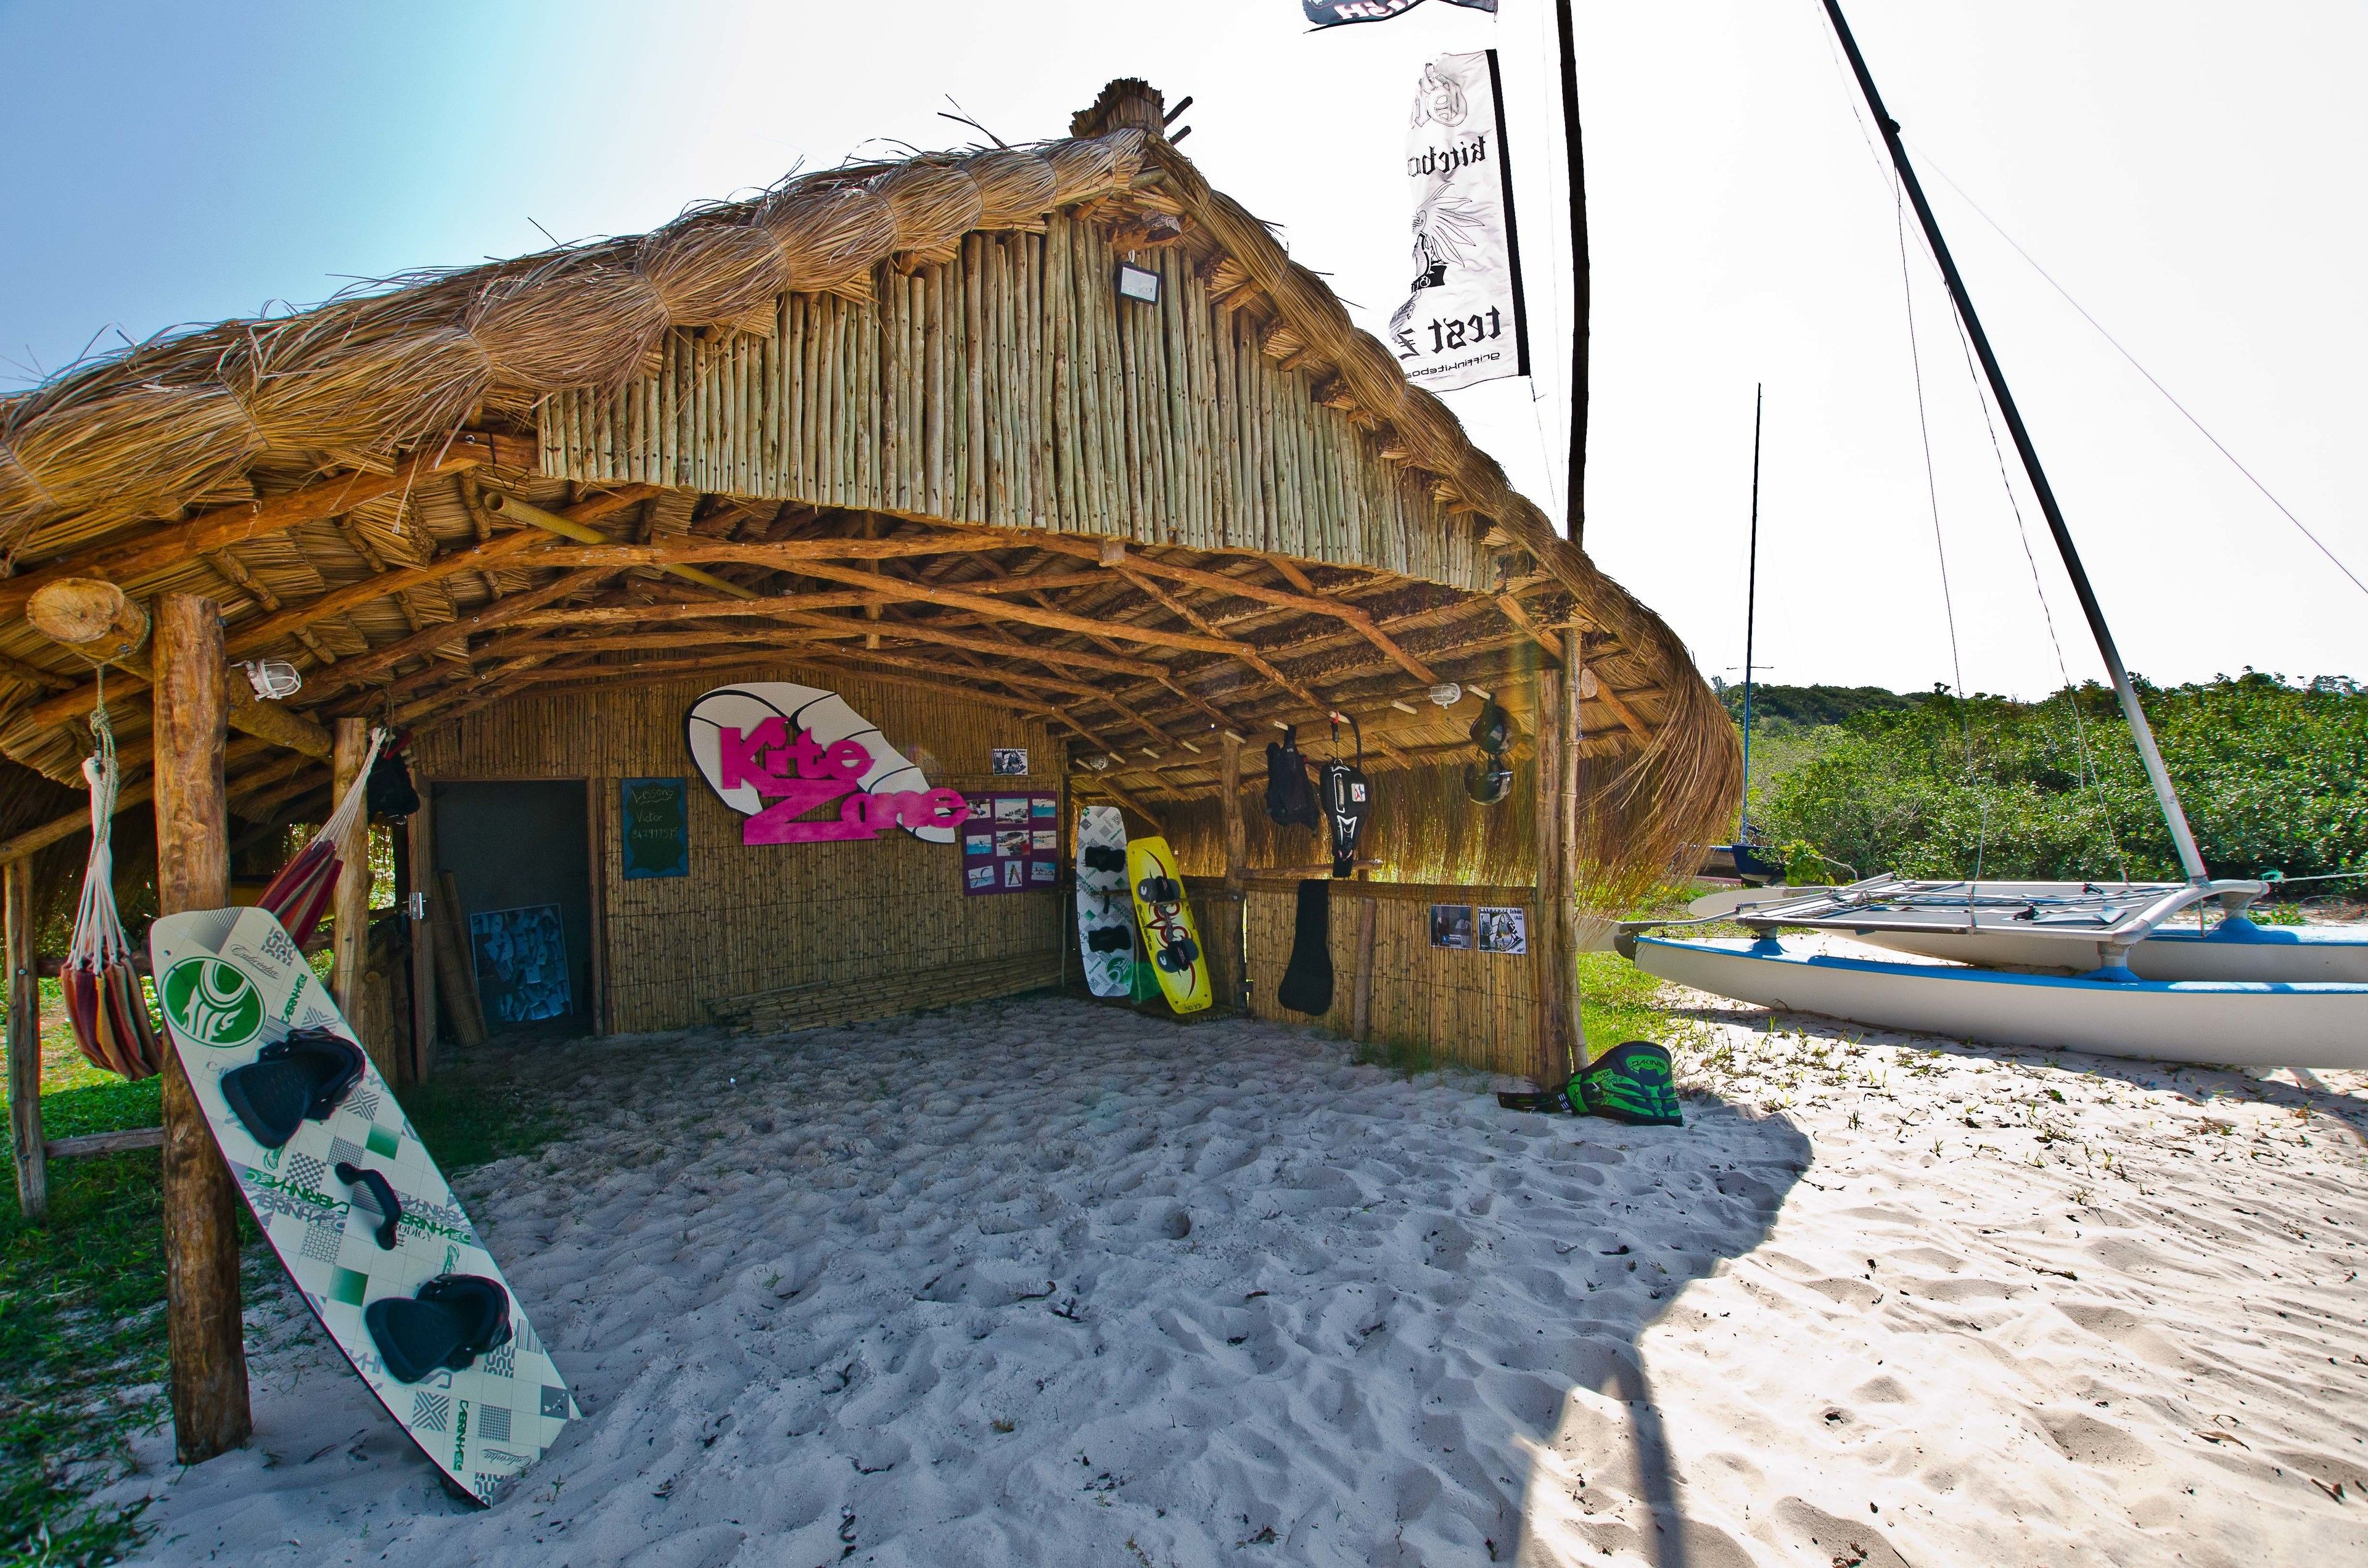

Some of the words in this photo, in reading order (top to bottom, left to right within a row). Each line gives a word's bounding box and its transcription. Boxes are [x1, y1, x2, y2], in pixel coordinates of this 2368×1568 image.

[720, 717, 875, 790] Kite
[744, 779, 971, 845] Zone
[1631, 1059, 1666, 1070] DAKINE
